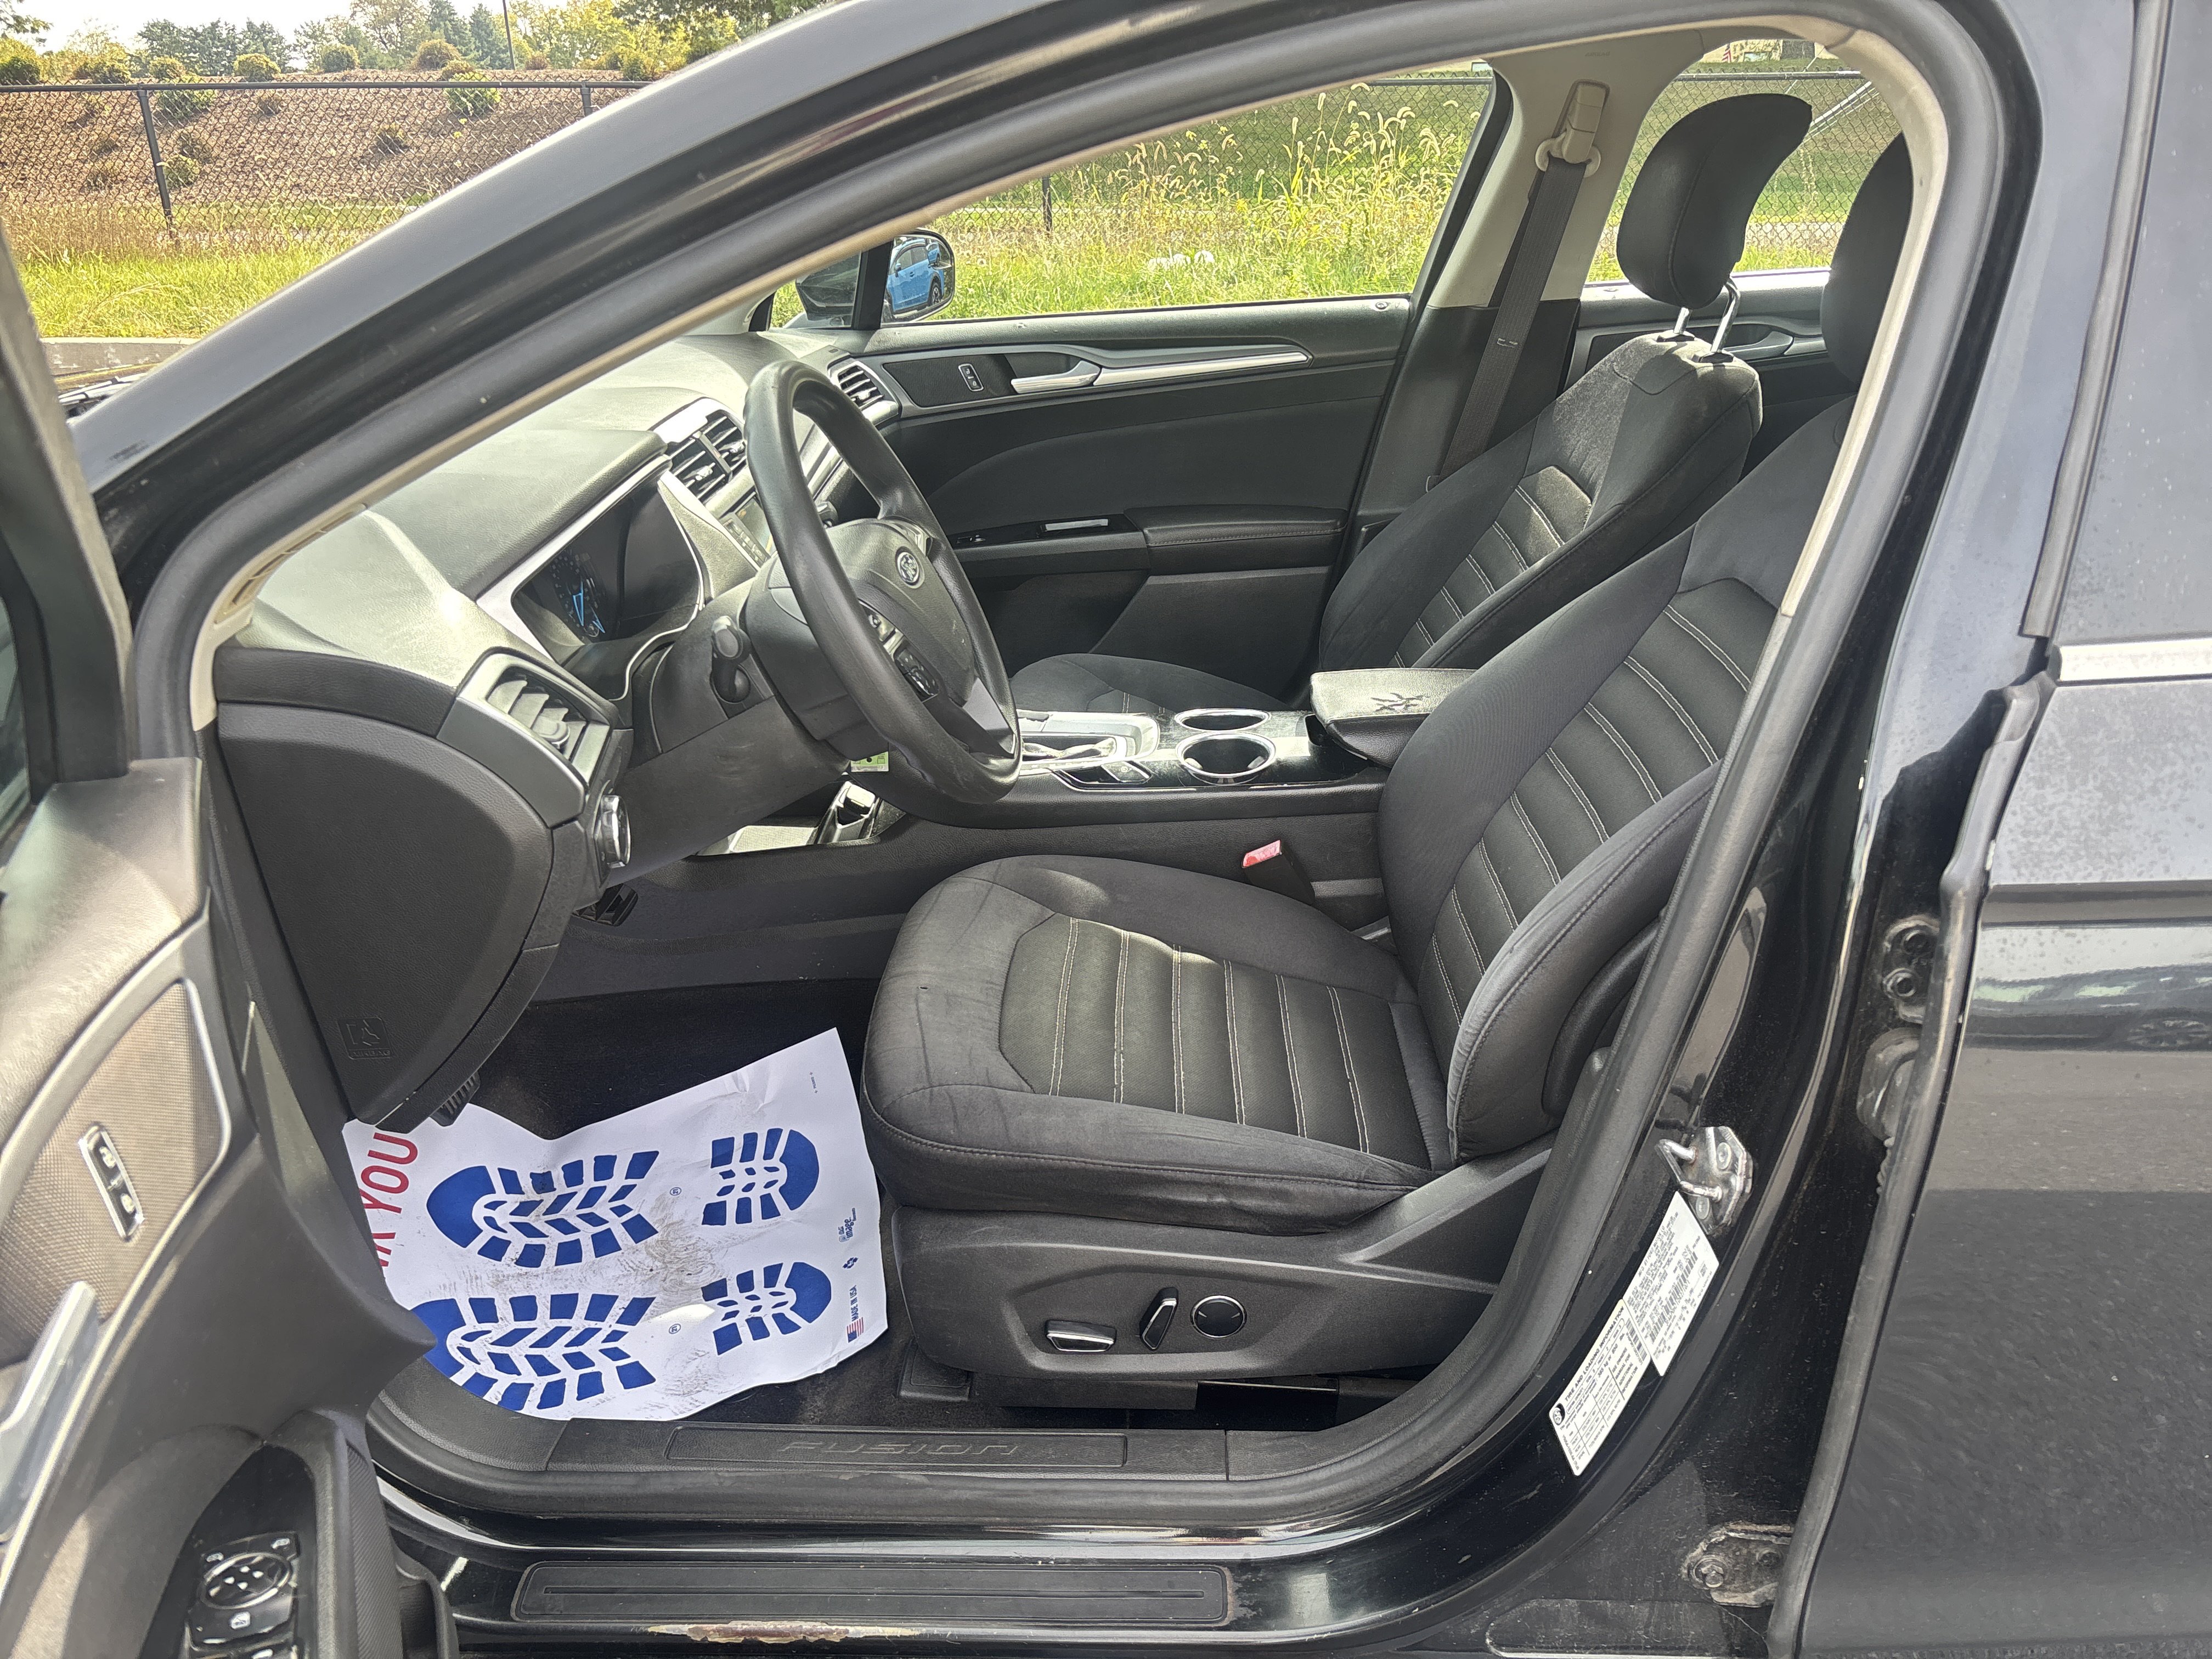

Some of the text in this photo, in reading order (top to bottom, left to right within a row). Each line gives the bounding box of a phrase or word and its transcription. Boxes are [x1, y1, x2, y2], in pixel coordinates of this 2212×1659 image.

[359, 1132, 419, 1214] YOU
[849, 1285, 859, 1322] MADE IN USA
[1564, 1387, 1575, 1403] TIRE
[1574, 1373, 1583, 1389] AND
[1582, 1347, 1600, 1375] LOADING
[1599, 1306, 1624, 1349] INFORMATION
[777, 1441, 1018, 1455] FUSION
